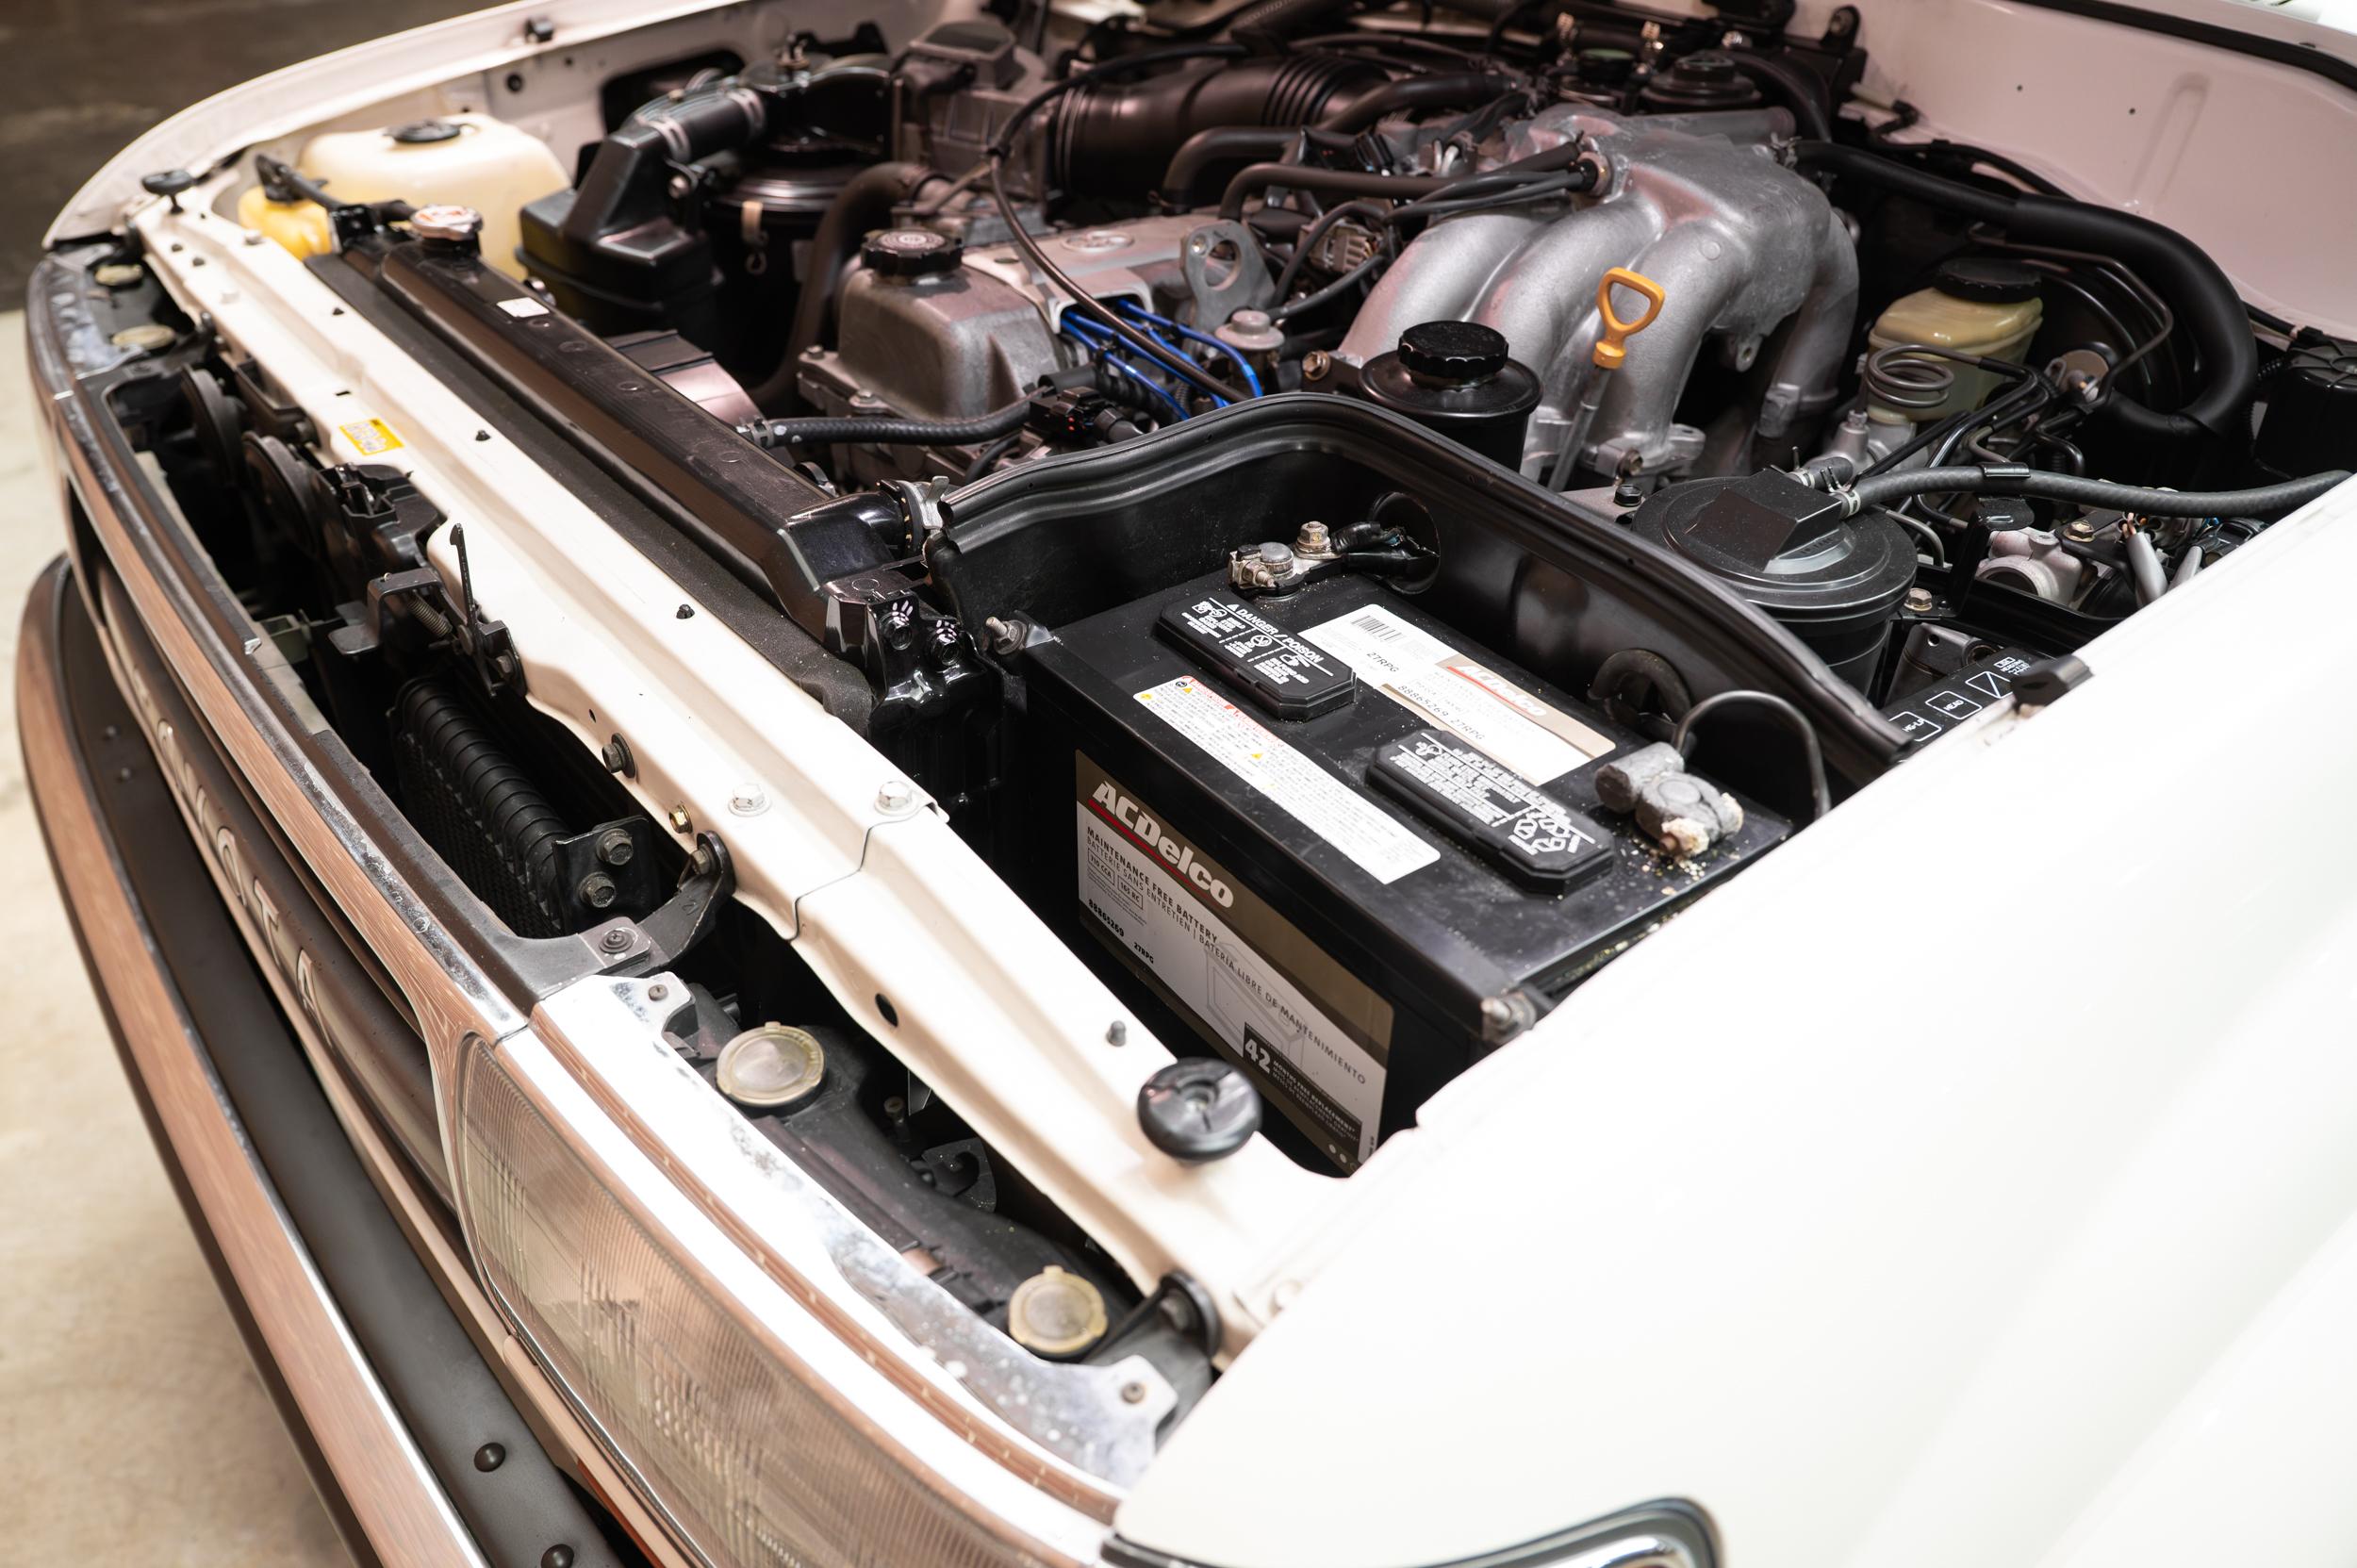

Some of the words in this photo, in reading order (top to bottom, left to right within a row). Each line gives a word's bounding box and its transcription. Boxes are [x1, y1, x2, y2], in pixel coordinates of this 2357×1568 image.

[1236, 608, 1278, 635] DANGER
[1282, 636, 1324, 663] POISON
[1366, 651, 1399, 672] 27RPG
[1397, 685, 1449, 717] 88865269
[1092, 781, 1234, 908] ACDelco
[1087, 827, 1149, 886] MAINTENANCE
[1152, 883, 1174, 907] FREE
[1176, 905, 1217, 944] BATTERY
[1087, 838, 1120, 872] BATTERIE
[1123, 869, 1143, 891] SANS
[1147, 890, 1189, 932] ENTRETIEN
[1237, 968, 1261, 996] LIBRE
[1265, 992, 1277, 1008] DE
[1280, 1005, 1366, 1085] MANTENIMIENTO
[1089, 899, 1124, 938] 88865269
[1133, 941, 1154, 965] 27RPG
[1244, 1038, 1271, 1074] 42
